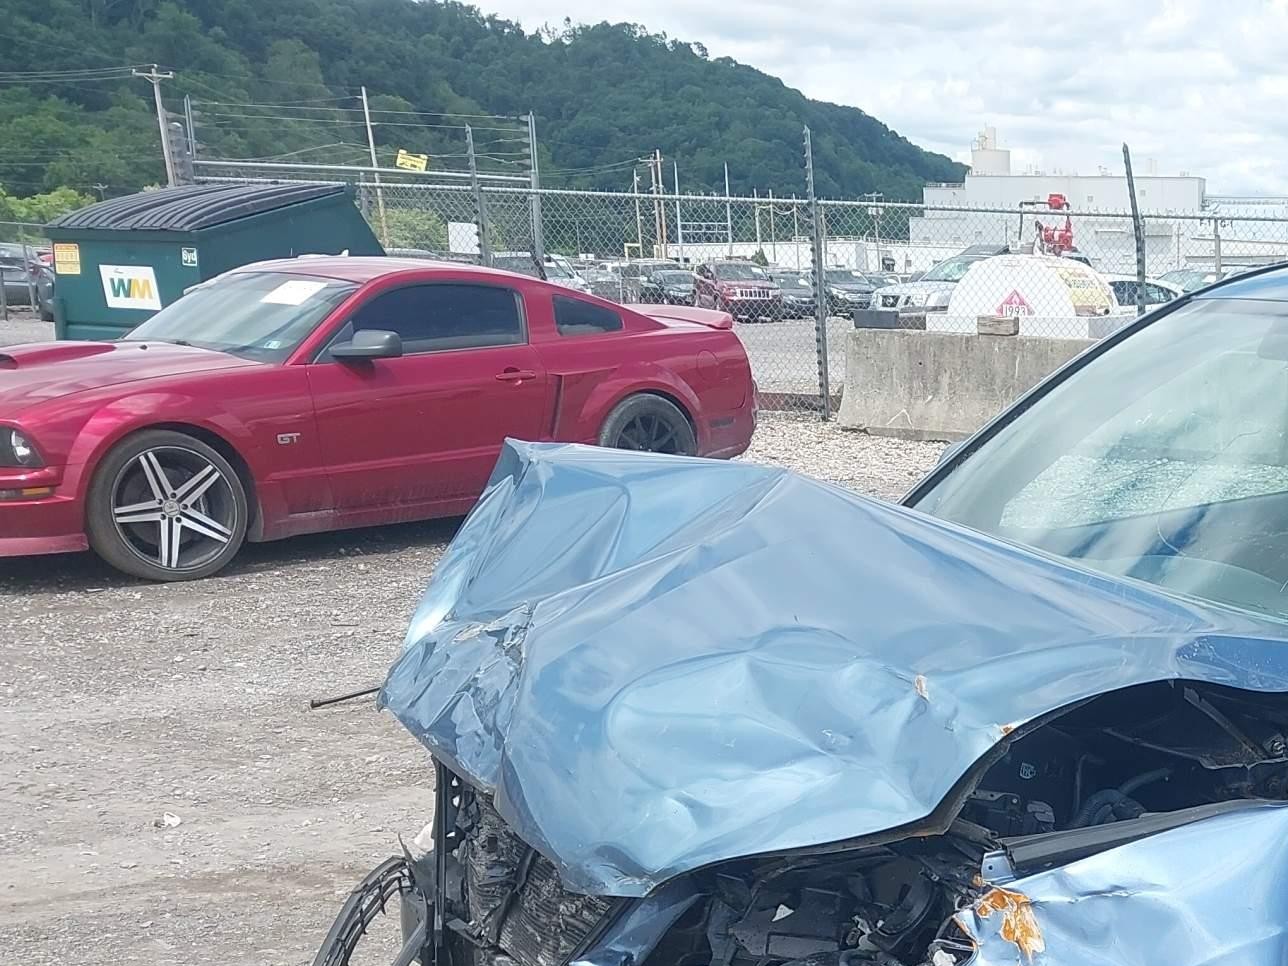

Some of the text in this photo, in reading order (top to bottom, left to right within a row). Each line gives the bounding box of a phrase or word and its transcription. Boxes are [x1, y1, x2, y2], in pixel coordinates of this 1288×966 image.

[109, 277, 153, 299] WM
[1005, 305, 1026, 317] 1993
[277, 432, 301, 444] GT
